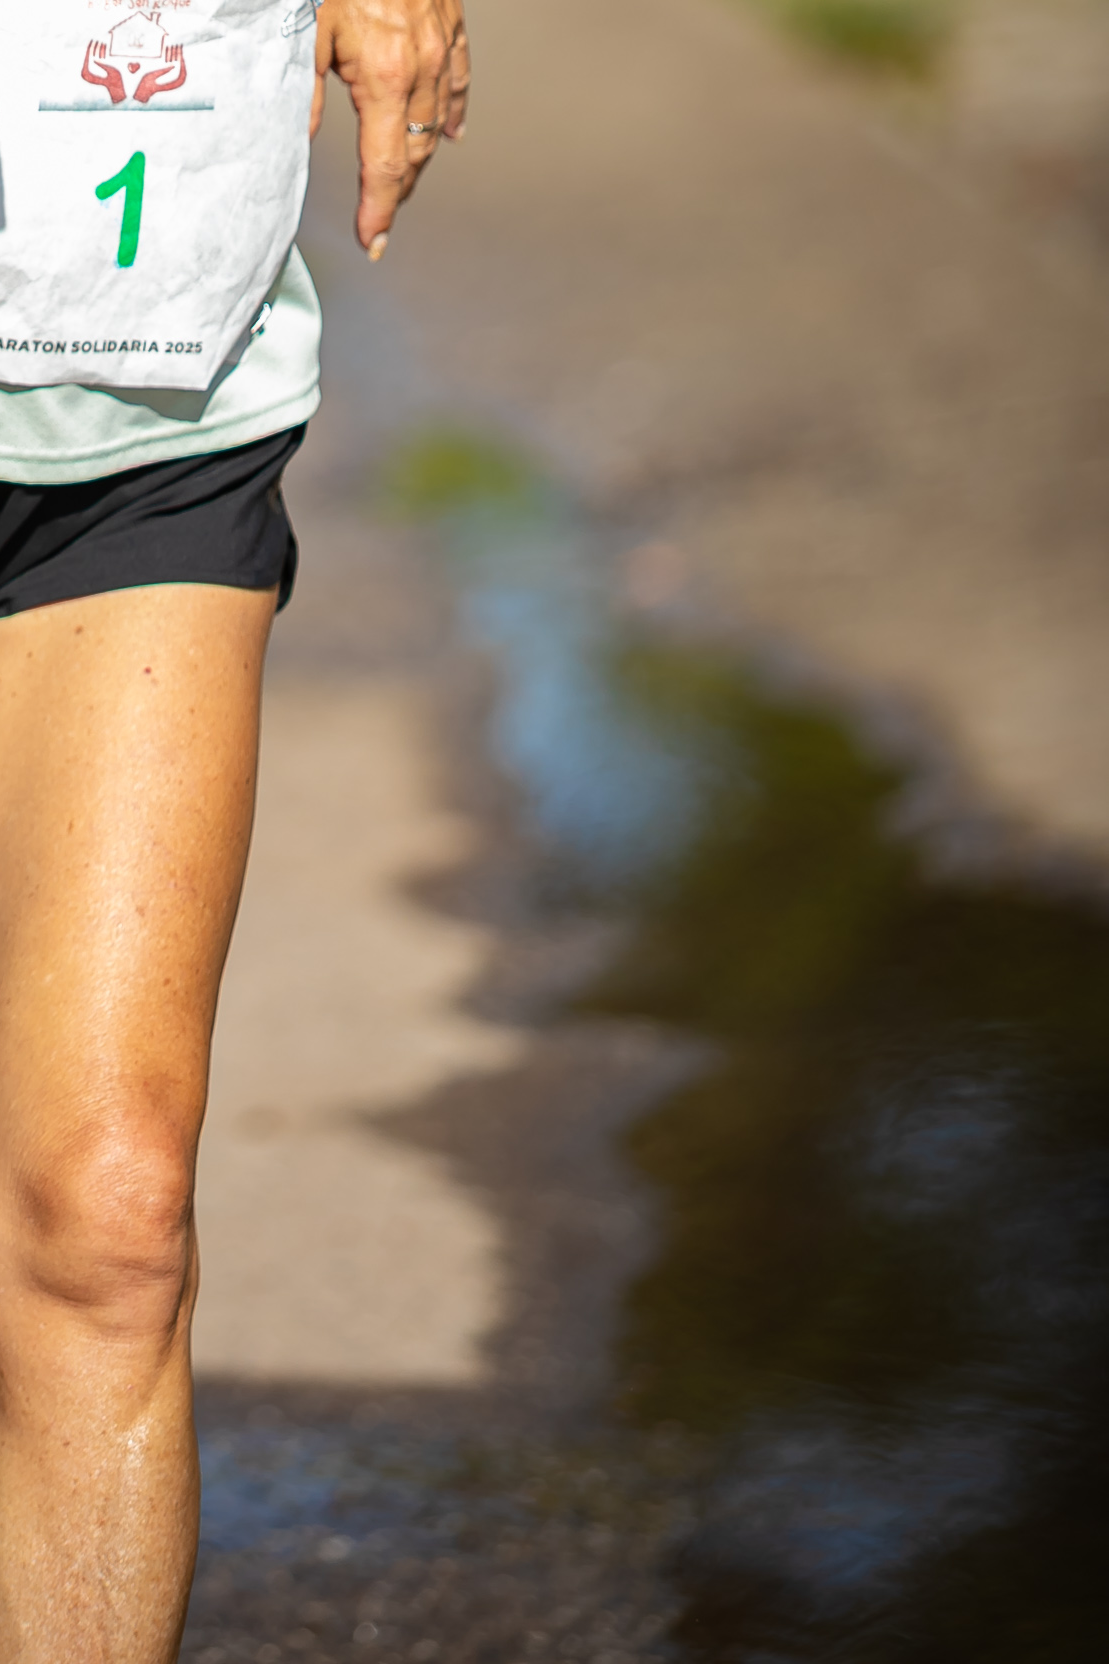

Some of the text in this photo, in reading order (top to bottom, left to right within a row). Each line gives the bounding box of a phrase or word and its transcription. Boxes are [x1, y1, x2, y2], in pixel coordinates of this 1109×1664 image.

[94, 149, 146, 268] 1
[71, 338, 159, 354] SOLIDARIA
[164, 340, 204, 354] 2025
